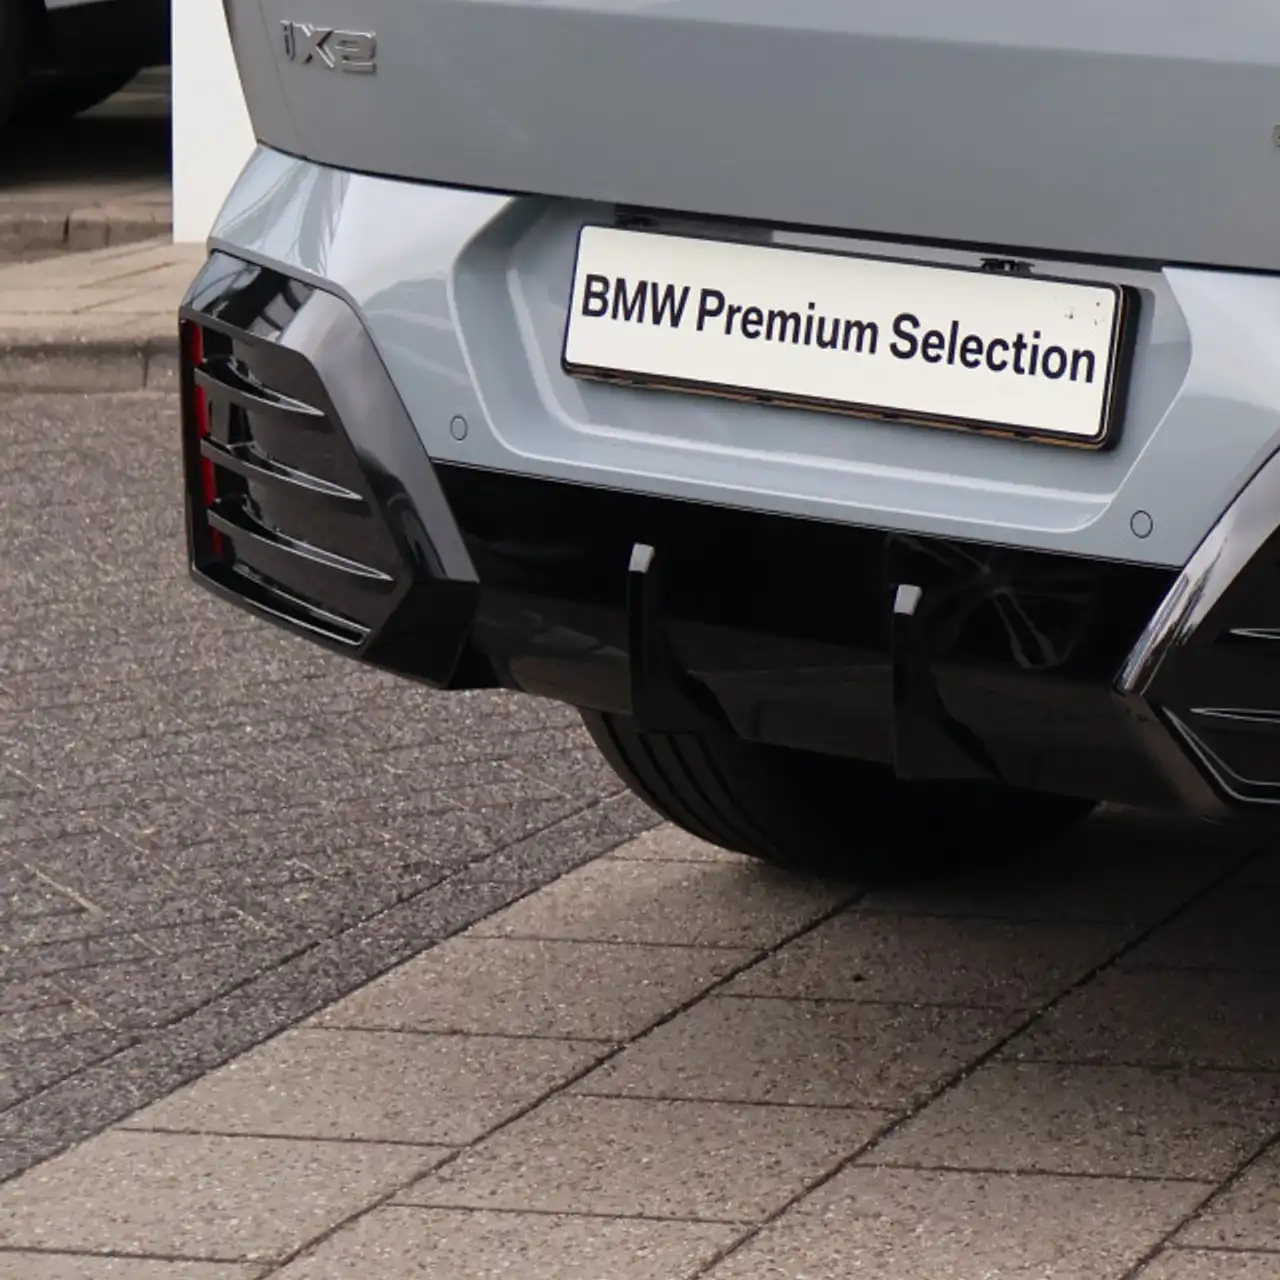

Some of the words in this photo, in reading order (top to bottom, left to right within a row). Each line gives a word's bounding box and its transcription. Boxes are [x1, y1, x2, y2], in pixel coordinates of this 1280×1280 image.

[580, 273, 692, 325] BMW
[695, 287, 880, 355] Premium
[888, 312, 1098, 384] Selection
